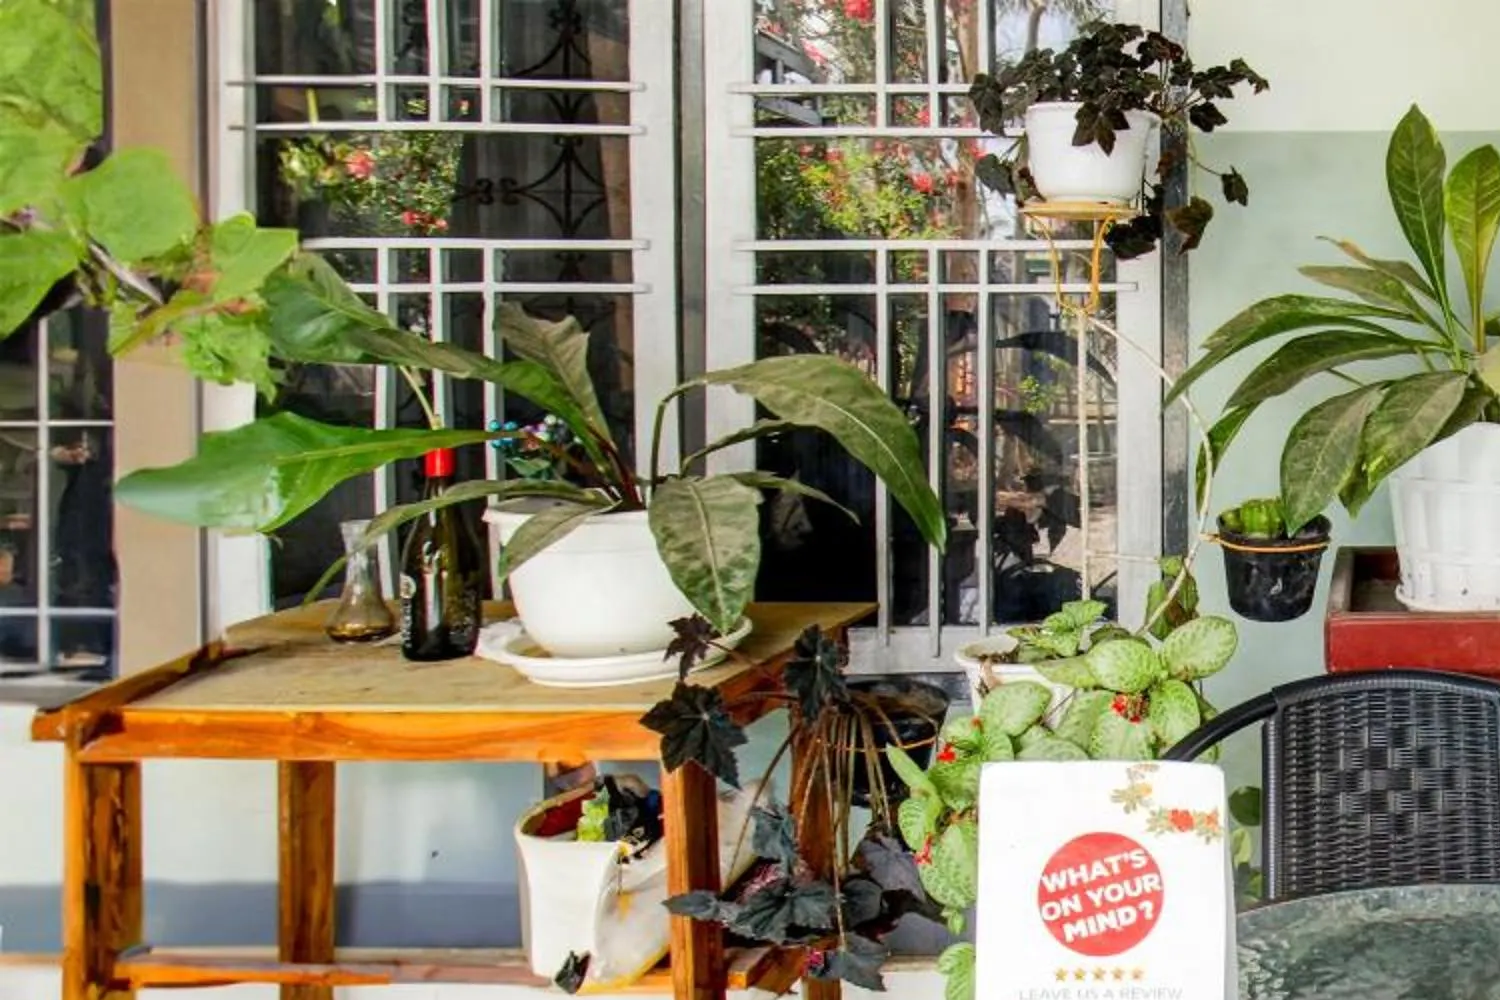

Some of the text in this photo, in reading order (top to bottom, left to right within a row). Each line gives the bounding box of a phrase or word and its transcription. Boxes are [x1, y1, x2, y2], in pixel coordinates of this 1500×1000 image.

[1041, 849, 1148, 892] WHAT'S
[1041, 873, 1162, 921] ON YOUR
[1063, 901, 1154, 942] MIND?
[1019, 987, 1182, 1000] LEAVE US A REVIEW
